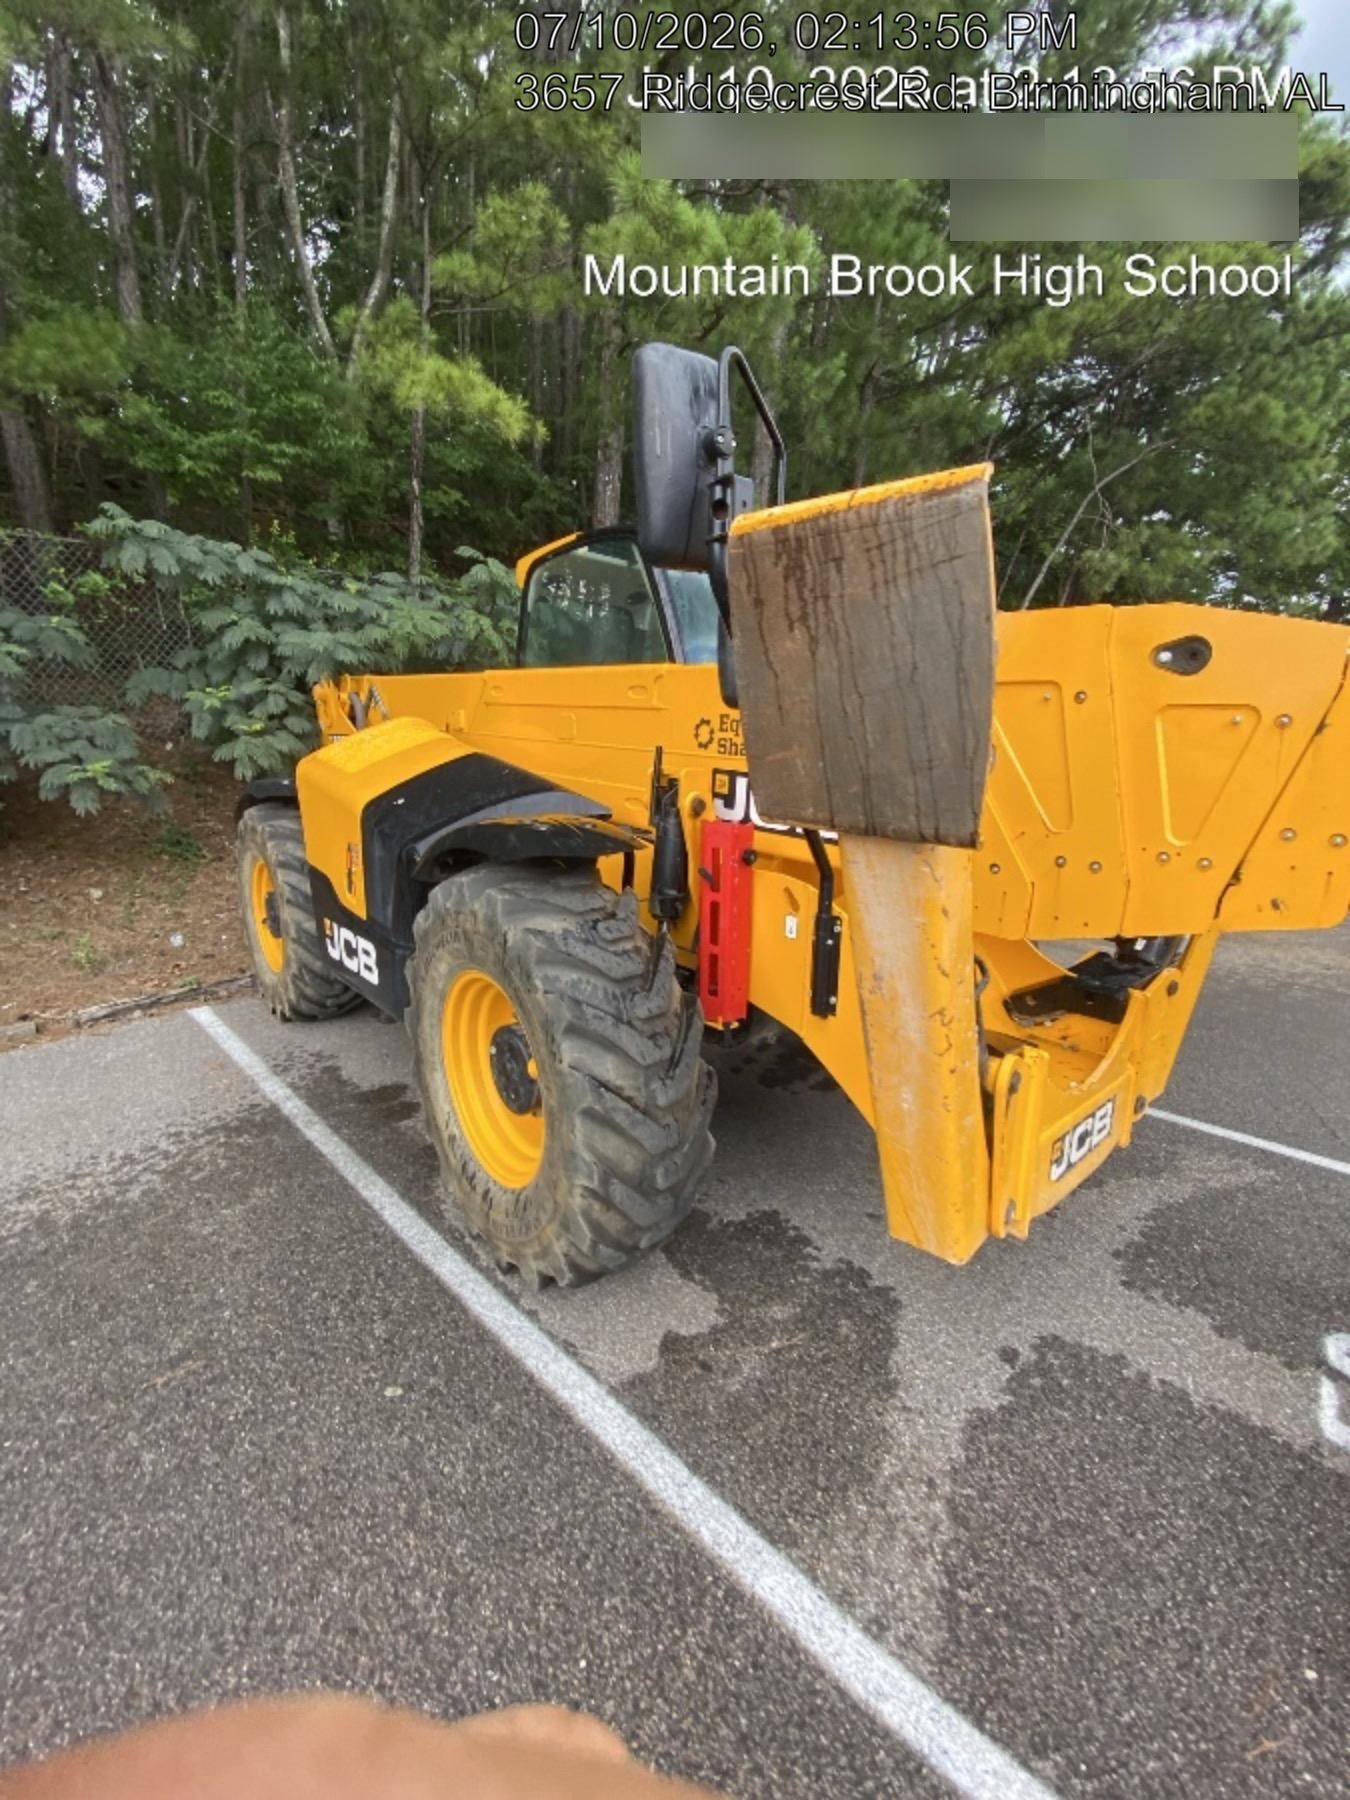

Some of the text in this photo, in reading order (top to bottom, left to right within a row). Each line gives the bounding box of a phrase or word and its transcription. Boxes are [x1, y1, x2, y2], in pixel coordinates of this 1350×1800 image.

[717, 738, 746, 756] Sha
[324, 919, 379, 987] JCB
[1051, 1101, 1113, 1181] JCB
